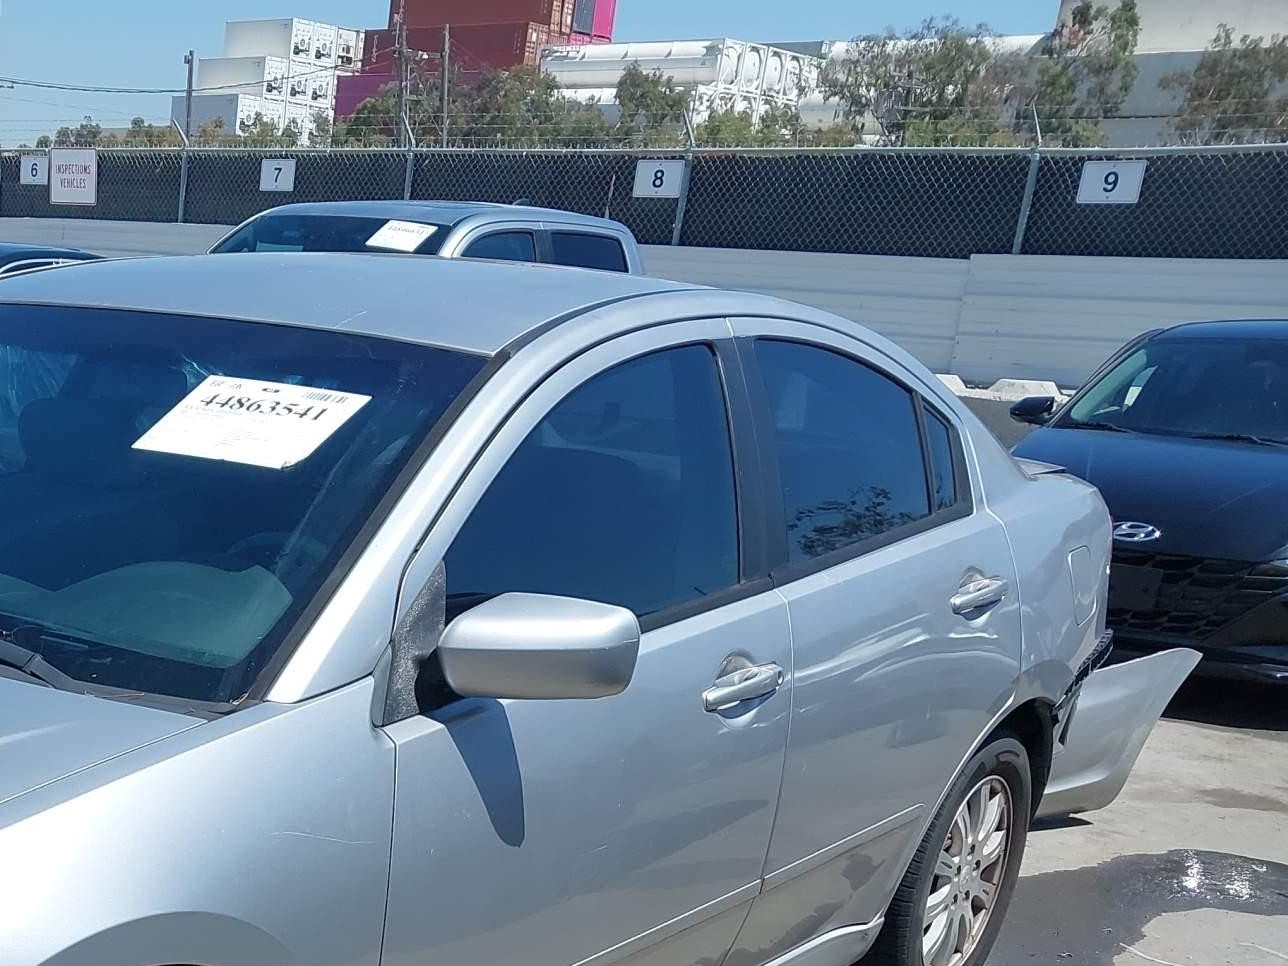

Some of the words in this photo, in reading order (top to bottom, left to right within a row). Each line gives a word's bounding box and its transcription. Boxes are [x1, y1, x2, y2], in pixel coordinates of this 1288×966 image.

[30, 162, 38, 178] 6
[274, 167, 283, 183] 7
[652, 169, 665, 188] 8
[60, 178, 87, 189] VEHICLES
[1102, 171, 1119, 193] 9
[200, 393, 329, 421] 44863541
